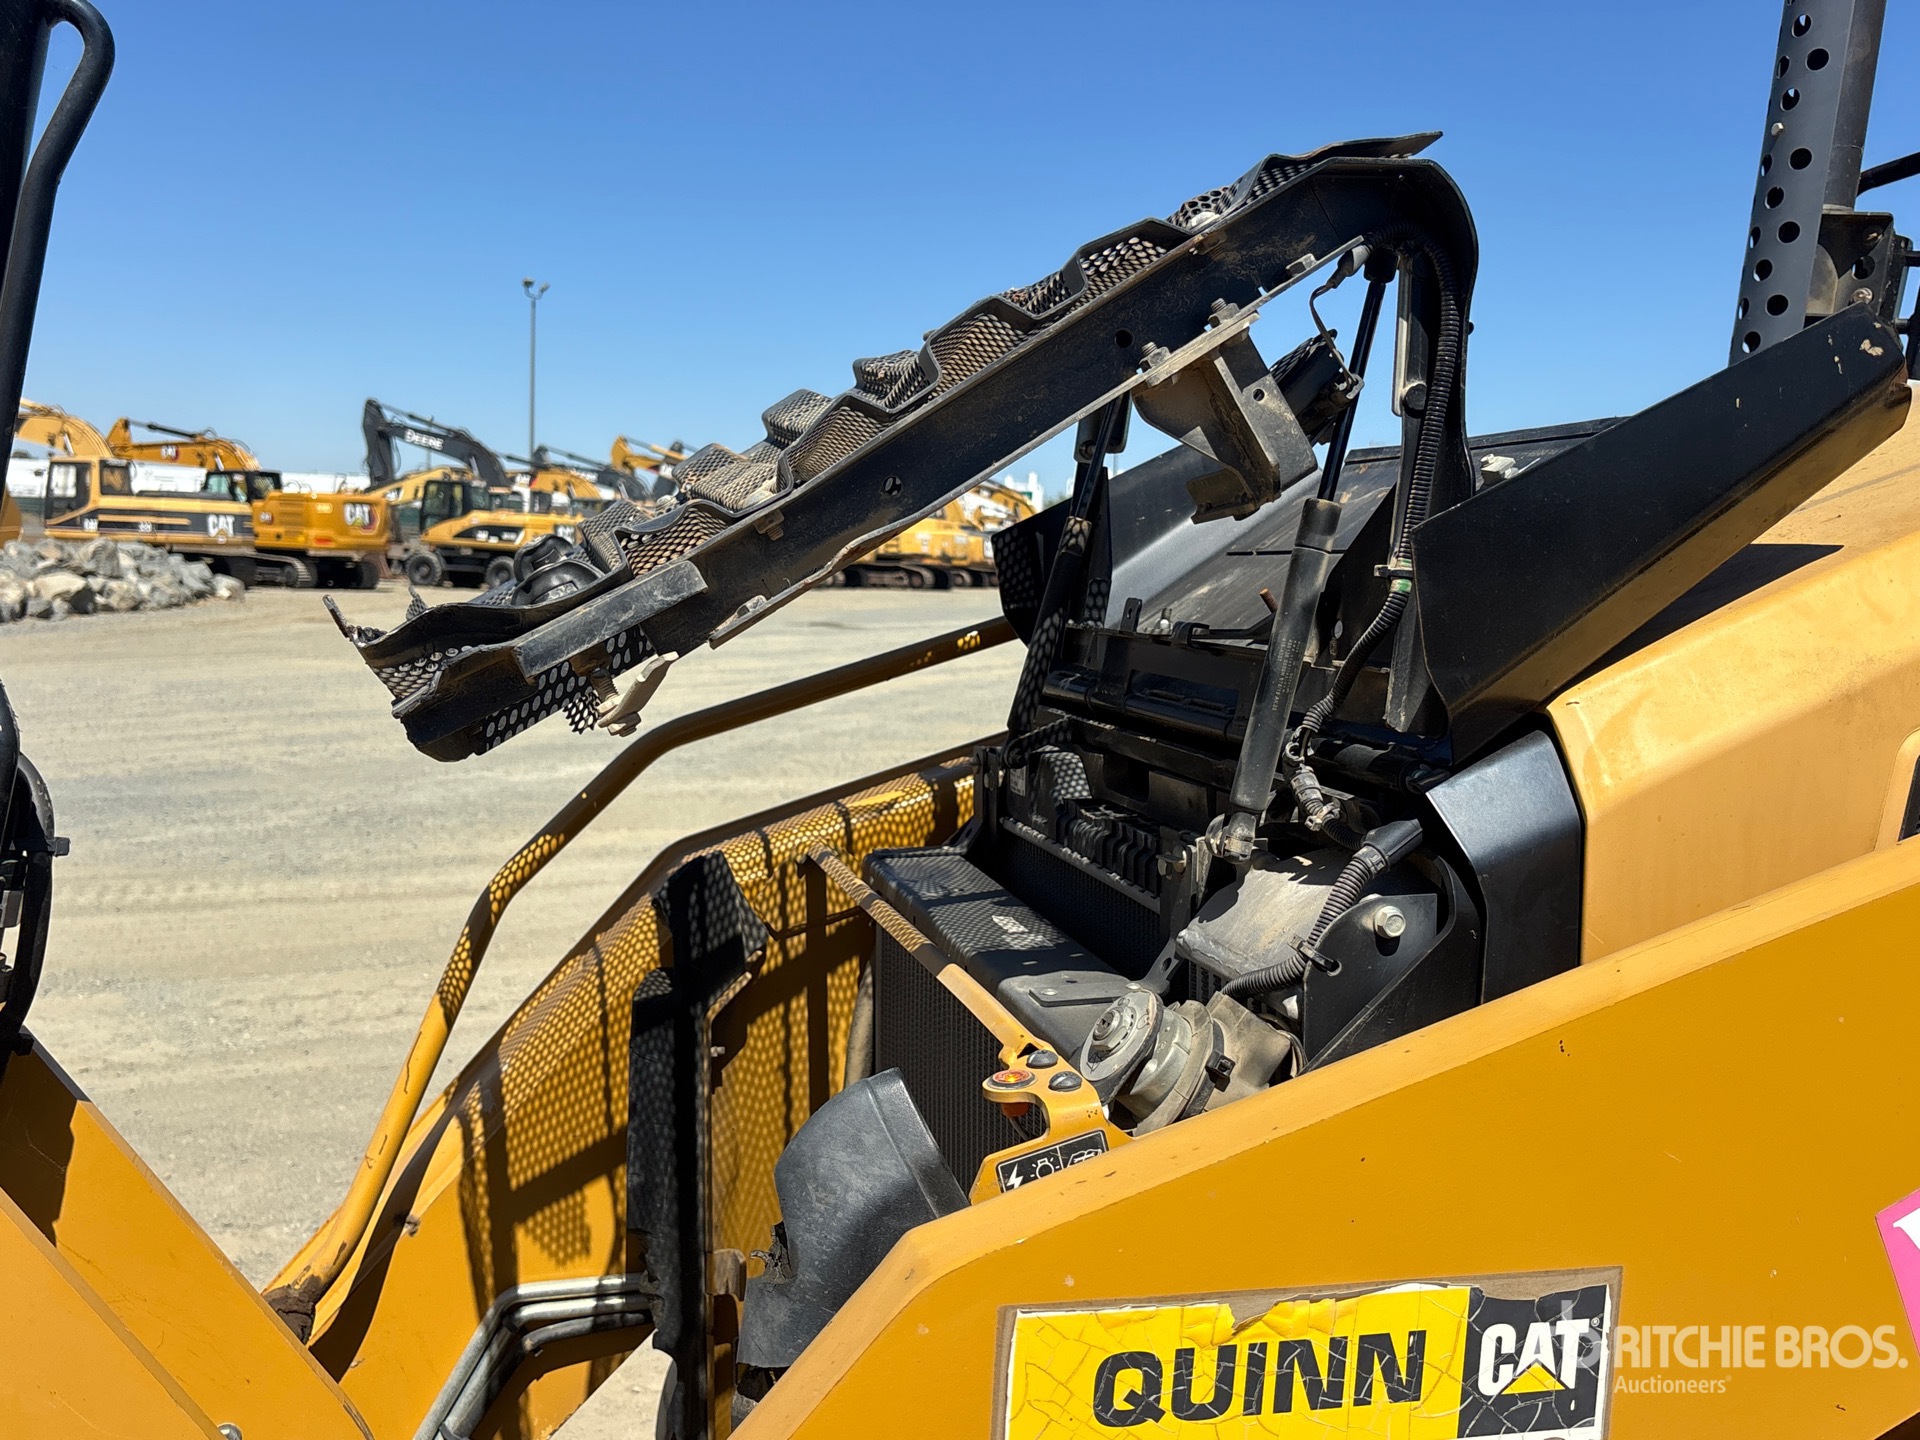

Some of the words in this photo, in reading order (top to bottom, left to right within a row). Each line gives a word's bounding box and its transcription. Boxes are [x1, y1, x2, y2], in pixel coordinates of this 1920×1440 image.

[405, 429, 445, 451] DEERE
[208, 514, 235, 537] CAT
[344, 503, 371, 526] CAT
[1093, 1330, 1427, 1428] QUINN
[1478, 1318, 1590, 1396] CAT
